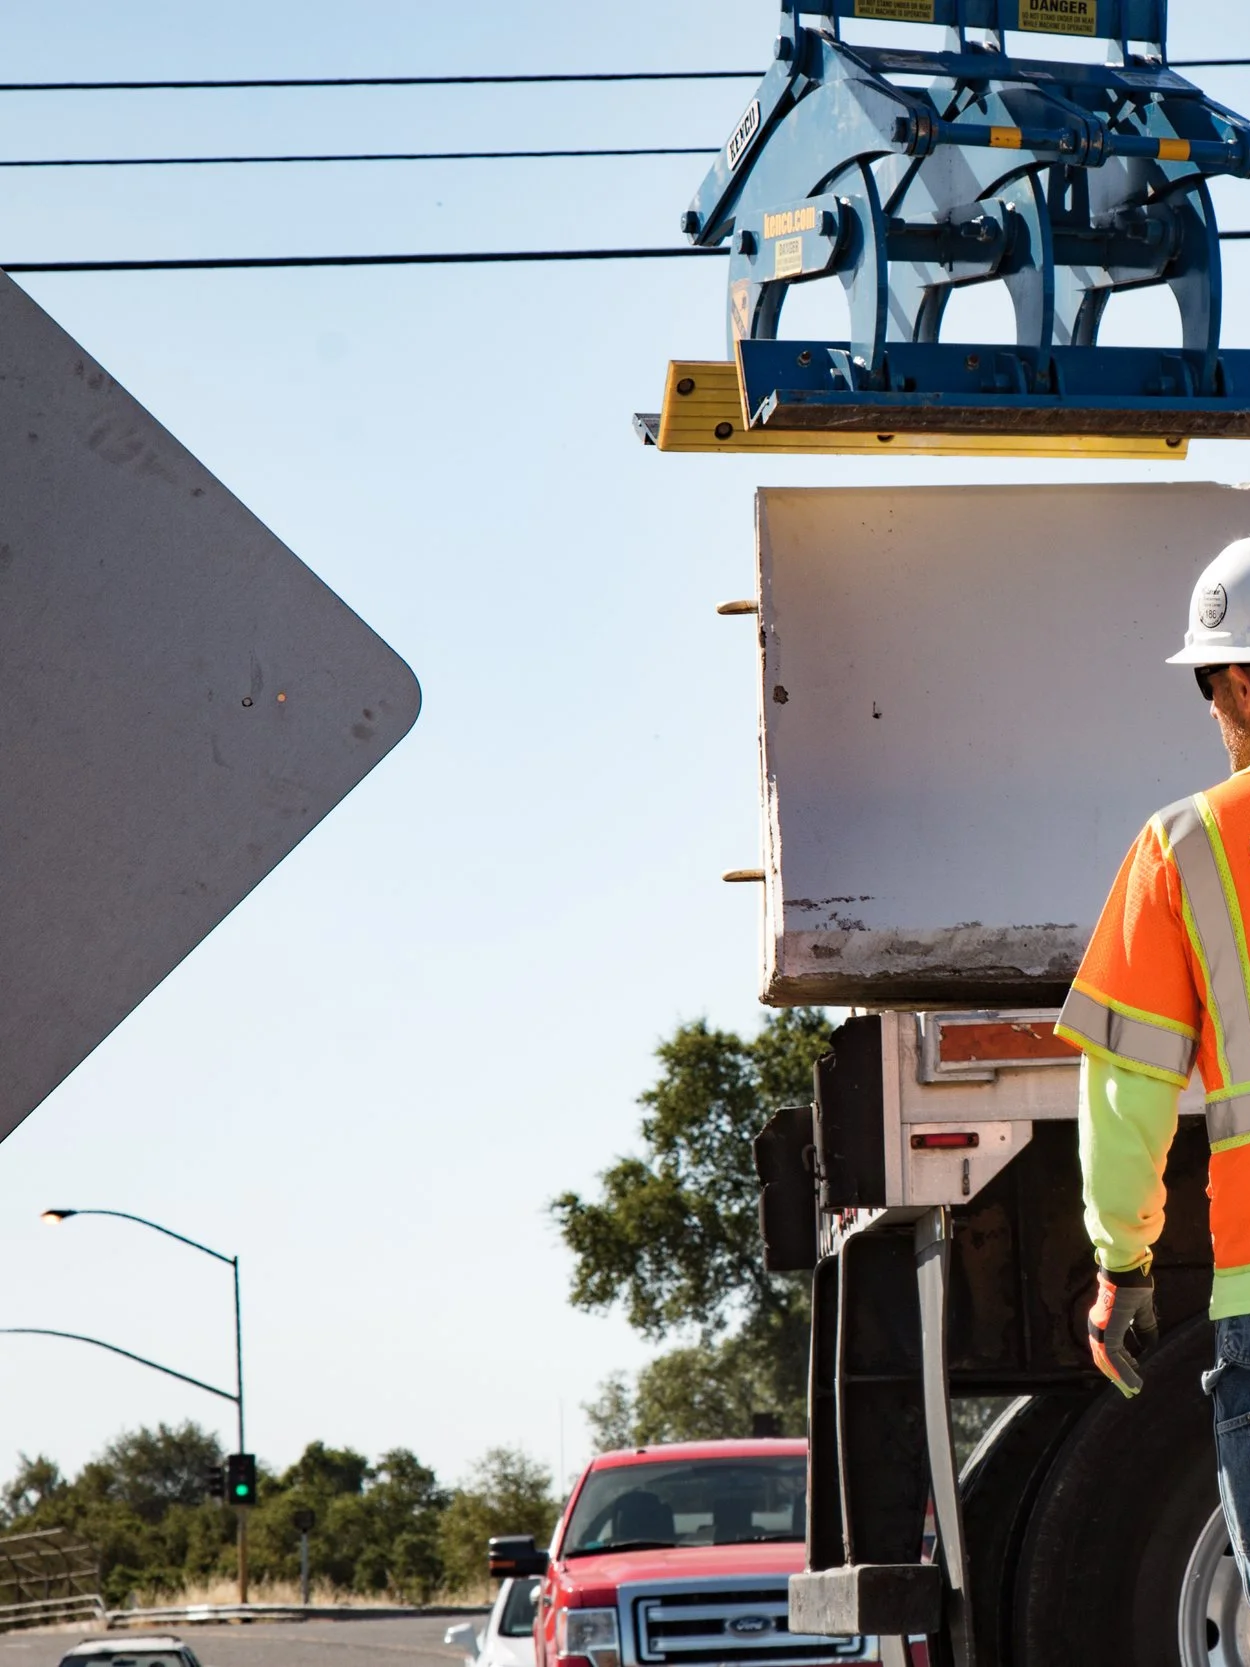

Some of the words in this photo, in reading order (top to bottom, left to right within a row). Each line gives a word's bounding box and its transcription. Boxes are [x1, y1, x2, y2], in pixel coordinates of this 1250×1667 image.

[1030, 0, 1087, 15] DANGER
[729, 107, 756, 162] KENCO
[764, 206, 816, 239] kenco.com
[737, 1619, 763, 1631] Ford
